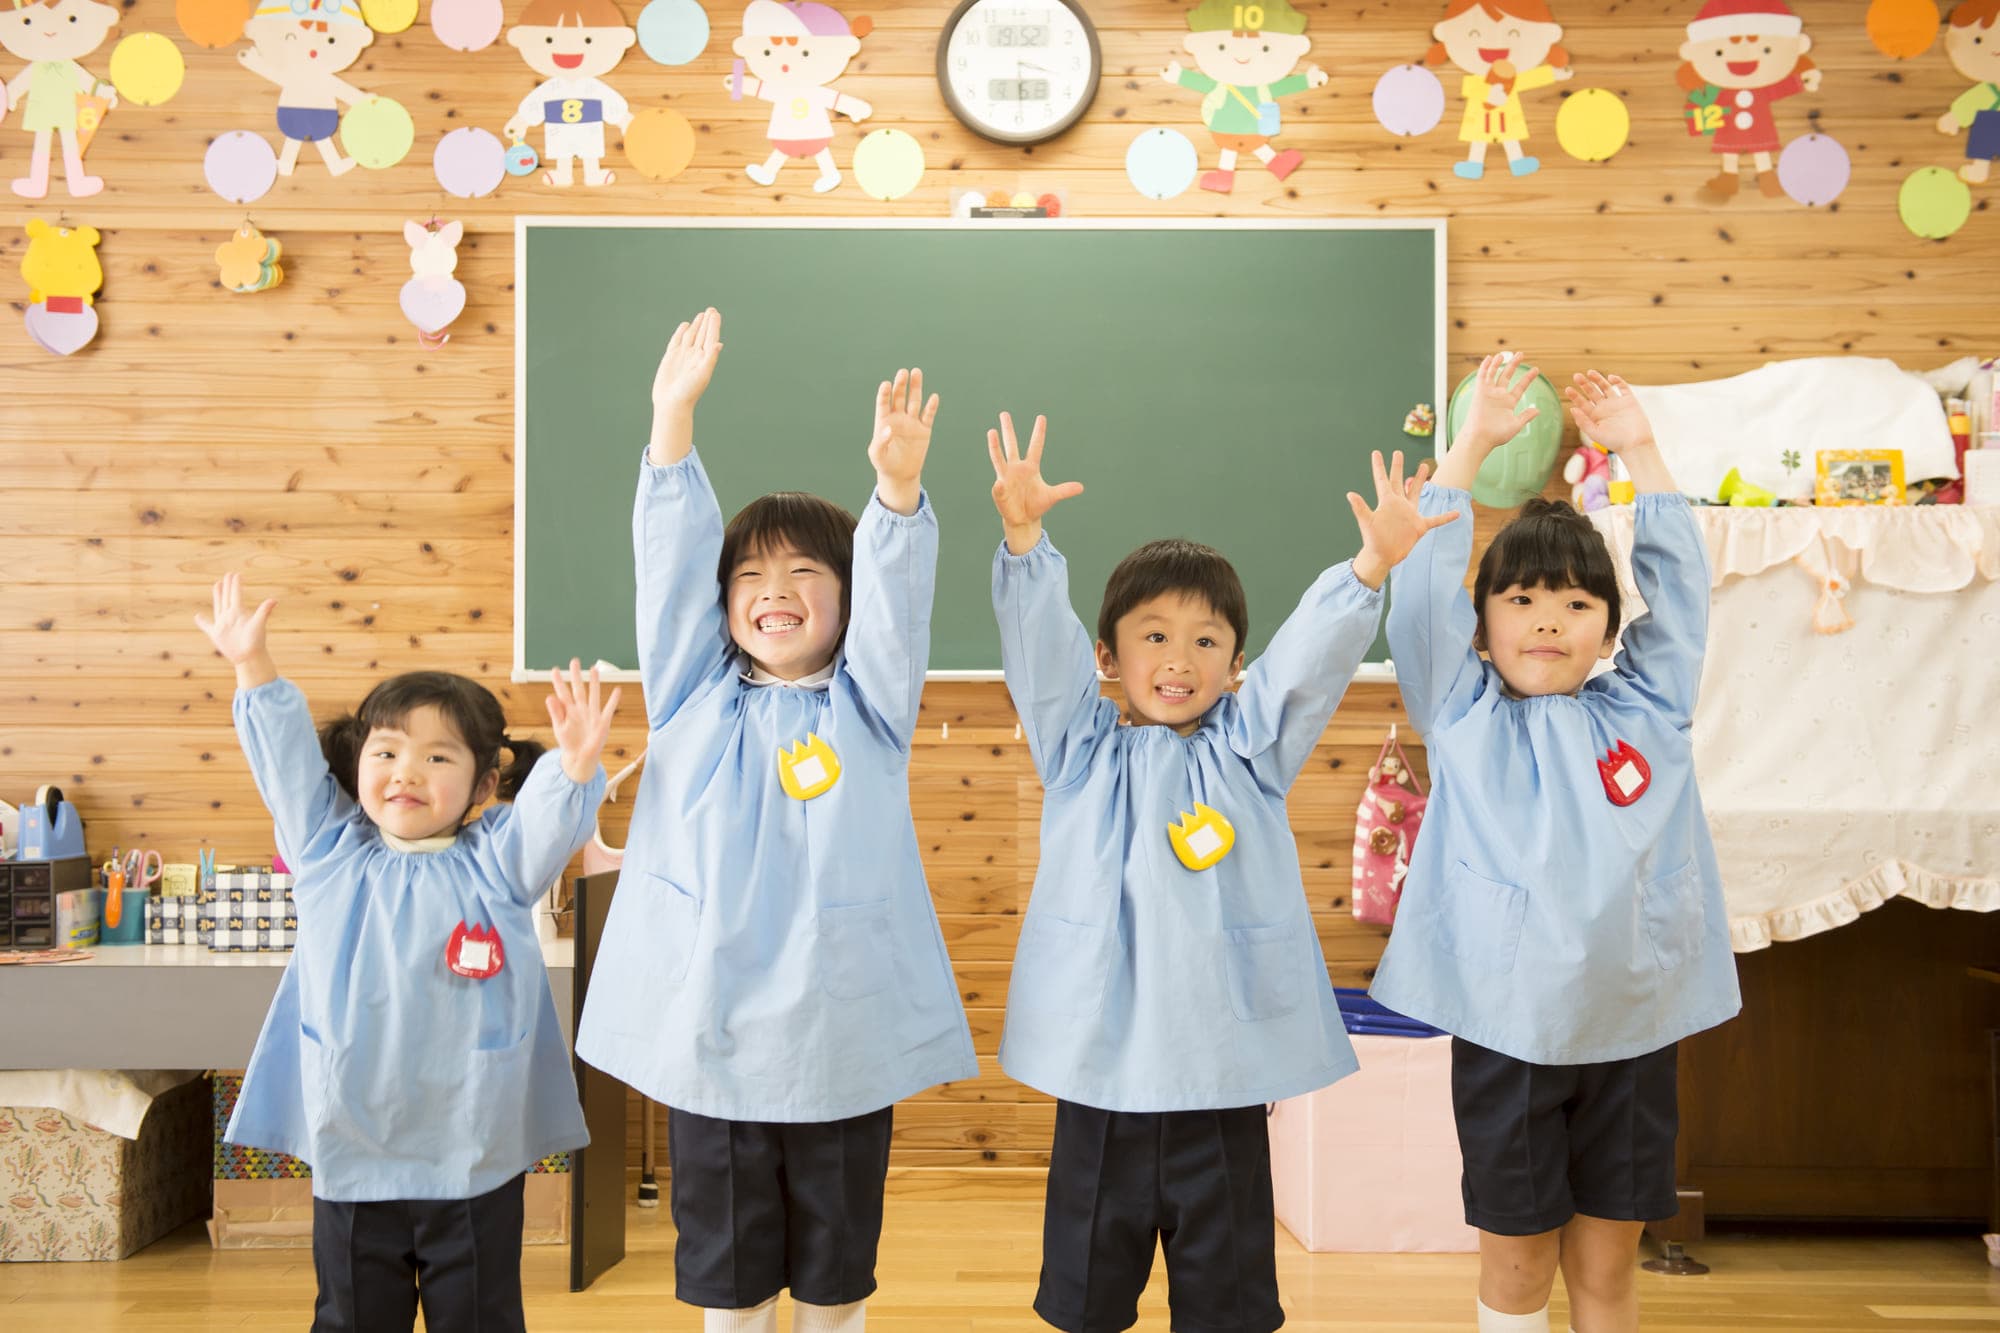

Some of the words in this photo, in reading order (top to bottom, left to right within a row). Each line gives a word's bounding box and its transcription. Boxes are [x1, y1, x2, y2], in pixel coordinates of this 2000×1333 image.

[1233, 5, 1264, 29] 10
[1072, 56, 1081, 71] 3
[79, 107, 97, 130] 6
[562, 99, 583, 123] 8
[791, 97, 809, 120] 9
[1693, 104, 1725, 132] 12
